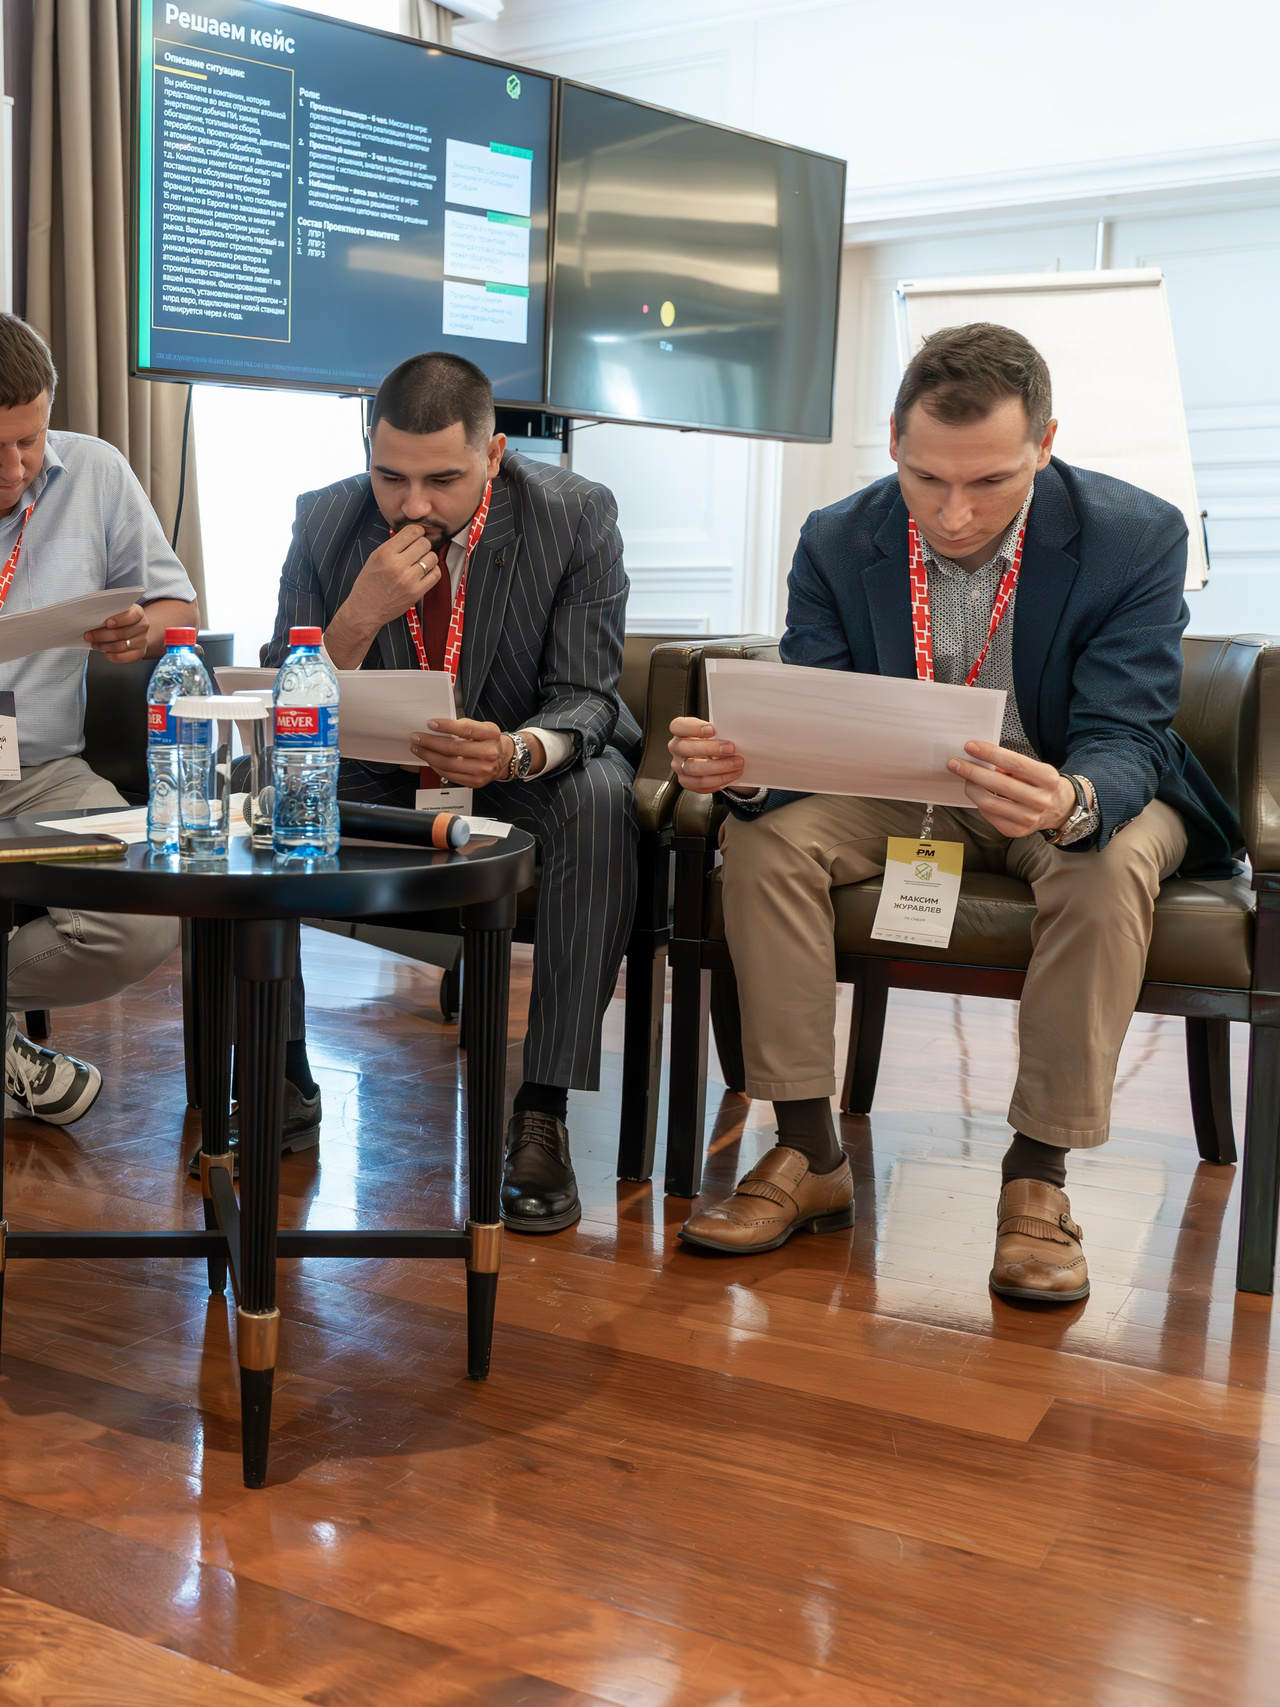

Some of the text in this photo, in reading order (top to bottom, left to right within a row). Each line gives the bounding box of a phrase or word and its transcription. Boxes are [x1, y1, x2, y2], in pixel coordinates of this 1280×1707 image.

[165, 3, 296, 54] Решаем кейс
[164, 51, 245, 78] Описание ситуации:
[297, 216, 322, 229] Состав
[324, 220, 365, 235] Проектного
[277, 716, 314, 727] MEVER
[916, 848, 936, 857] PM
[900, 894, 938, 904] МАКСИМ
[894, 902, 942, 914] ЖУРАВЛЕВ
